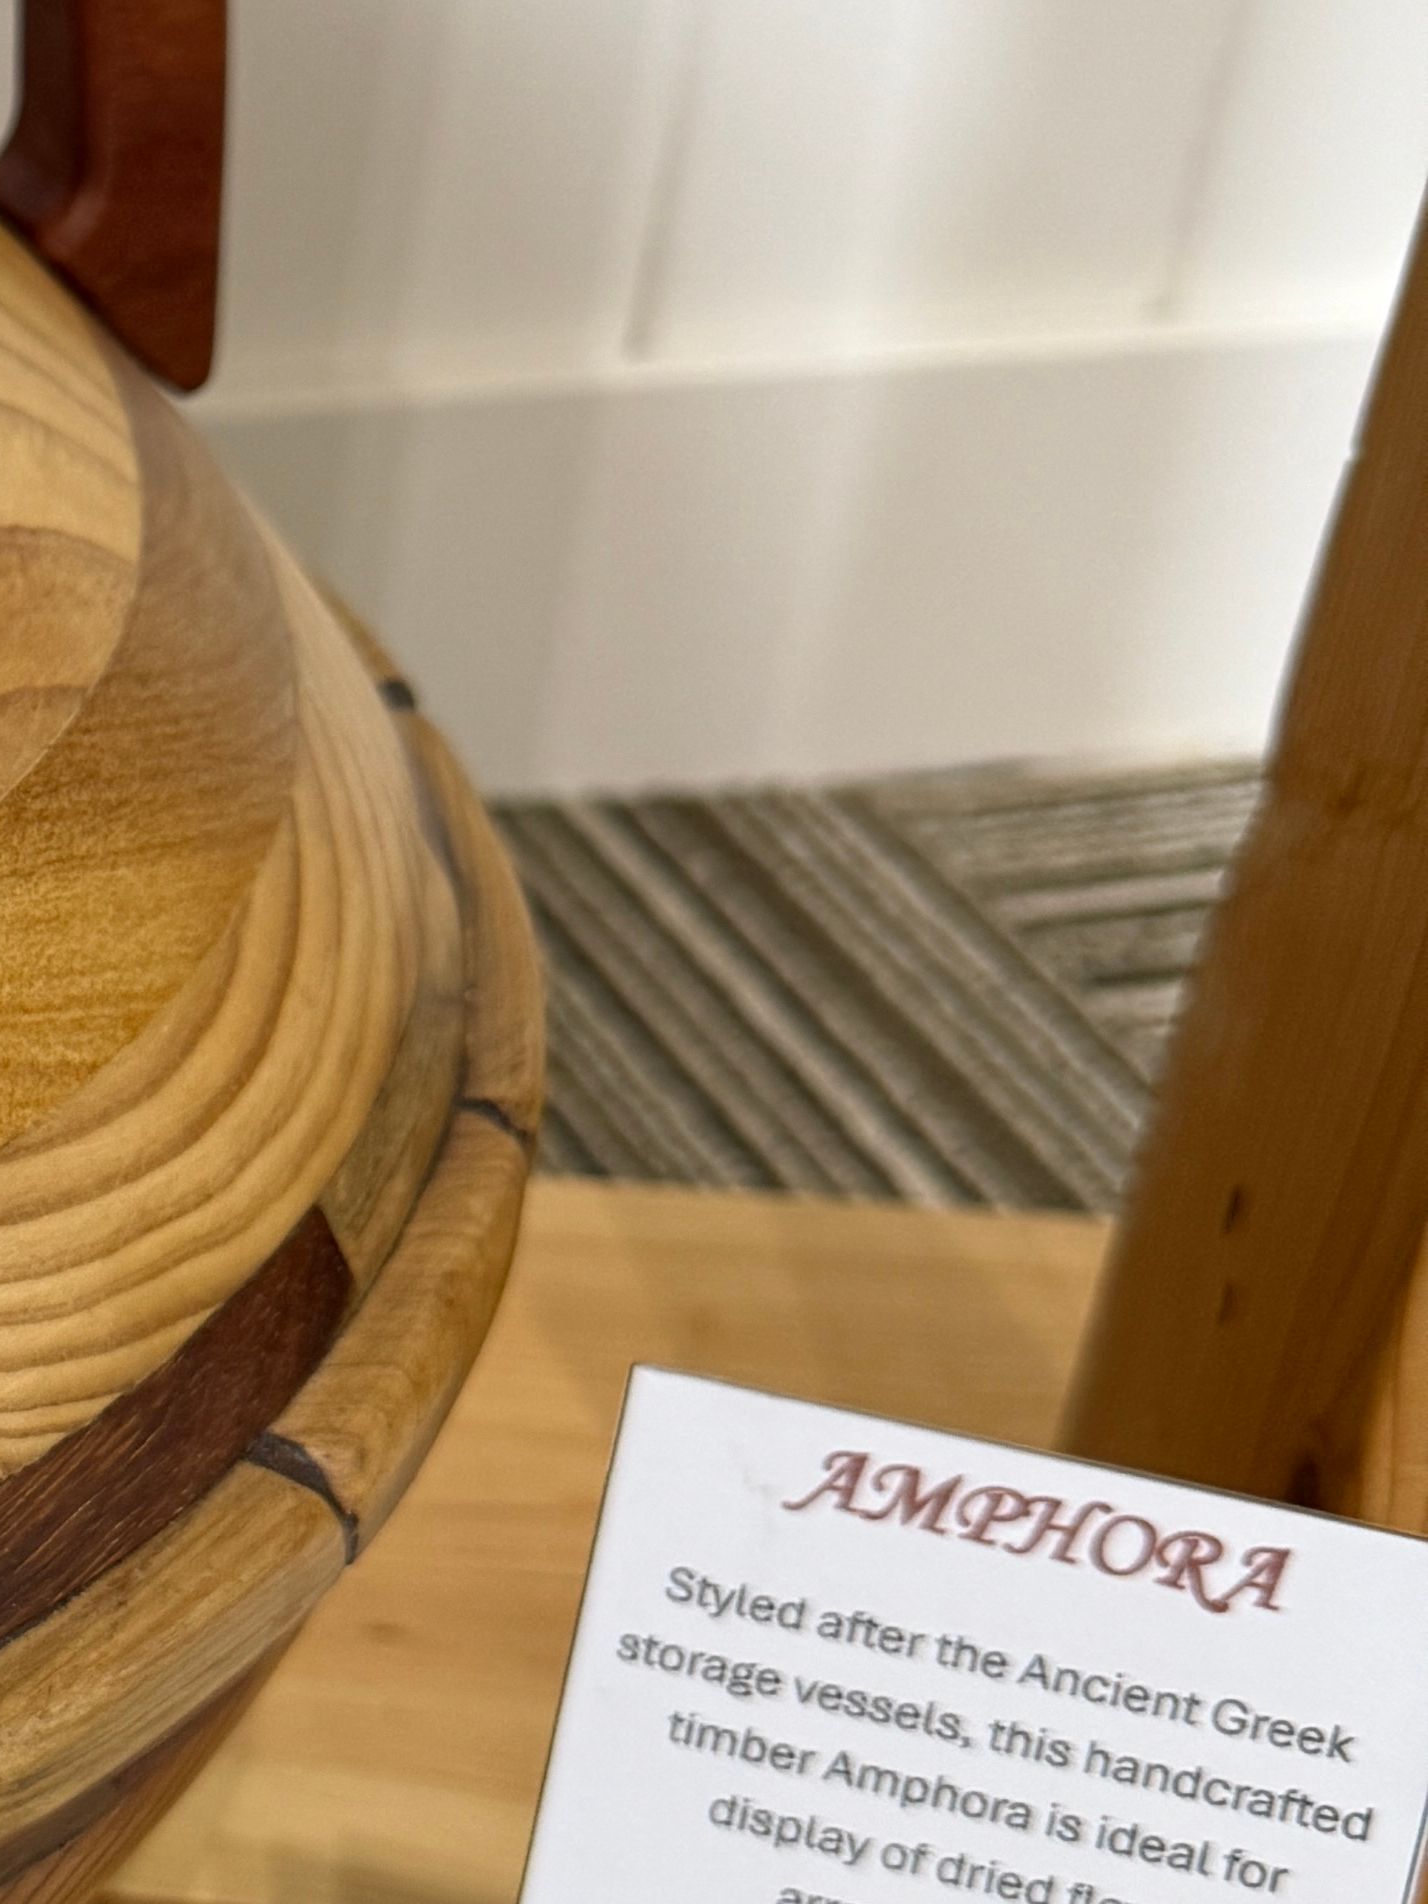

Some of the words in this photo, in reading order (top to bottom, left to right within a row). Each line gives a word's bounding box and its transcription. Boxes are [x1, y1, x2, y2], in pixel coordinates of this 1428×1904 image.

[781, 1450, 1292, 1613] AMPHORA
[616, 1633, 783, 1697] storage
[794, 1677, 971, 1748] vessels,
[988, 1720, 1072, 1768] this
[1083, 1741, 1374, 1842] handcrafted
[665, 1566, 807, 1631] Styled
[817, 1611, 926, 1657] after
[936, 1634, 1009, 1679] the
[1017, 1654, 1202, 1726] Ancient
[1211, 1698, 1354, 1763] Greek
[669, 1712, 816, 1774] timber
[822, 1751, 1033, 1831] Amphora
[1045, 1802, 1083, 1842] is
[1095, 1815, 1211, 1876] ideal
[1223, 1848, 1289, 1893] for
[709, 1795, 870, 1866] display
[881, 1842, 930, 1874] of
